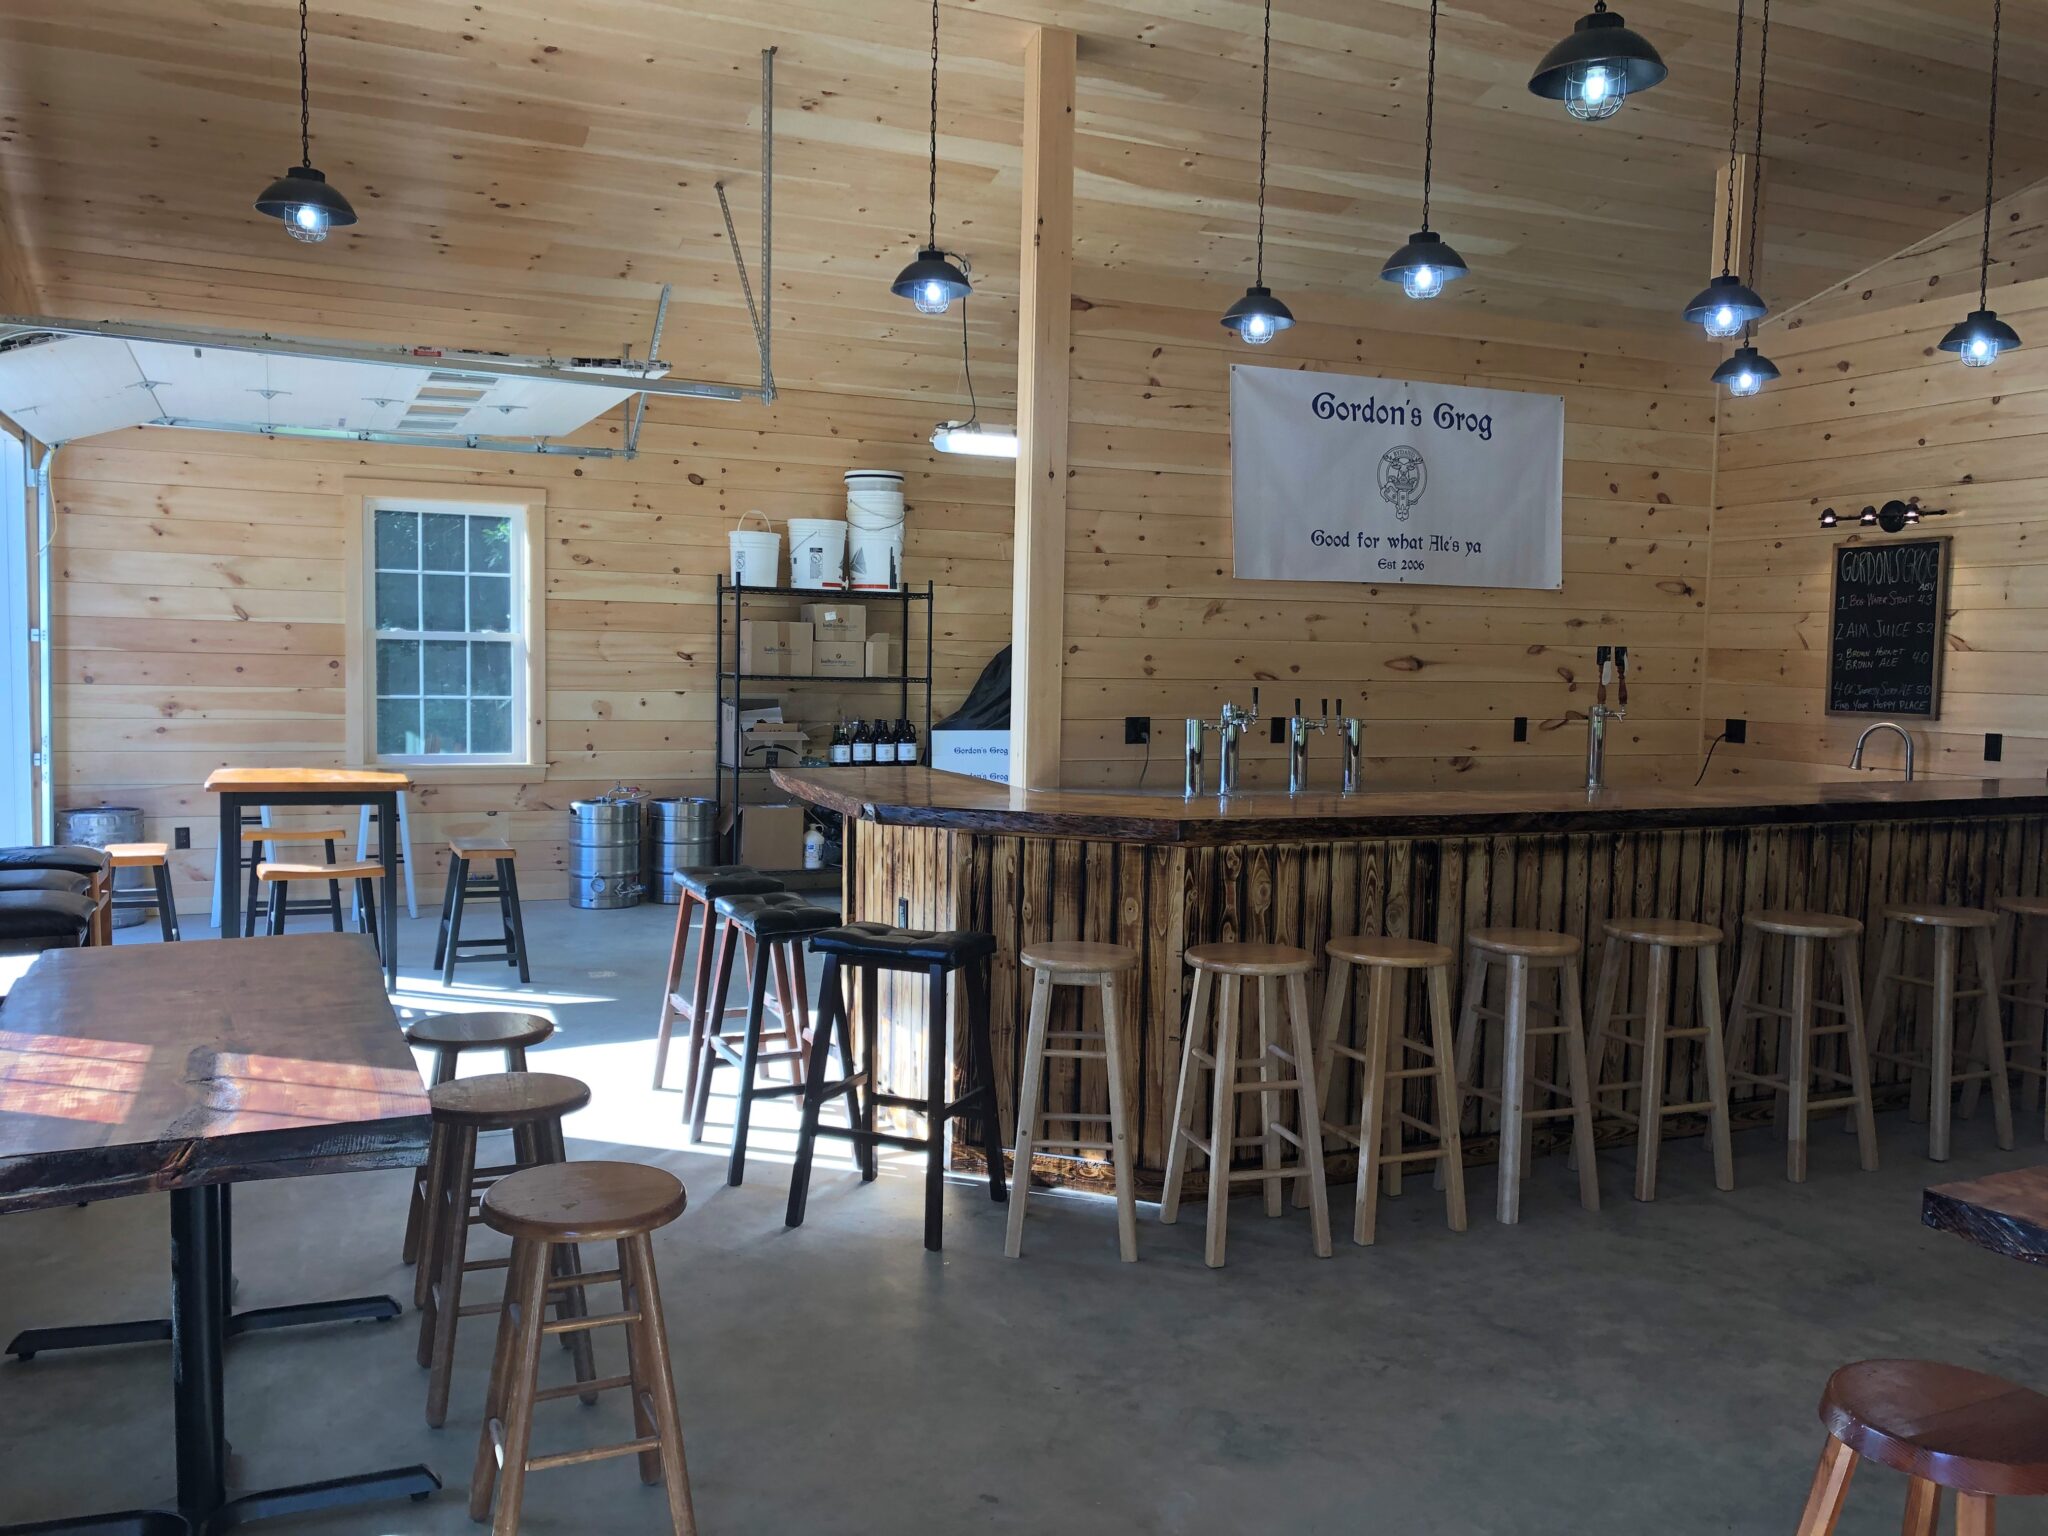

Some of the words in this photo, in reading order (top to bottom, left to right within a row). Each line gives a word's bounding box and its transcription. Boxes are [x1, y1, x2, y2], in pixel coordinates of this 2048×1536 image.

[1311, 392, 1422, 427] Gordon's
[1433, 402, 1493, 441] Grog
[1310, 529, 1350, 548] Good
[1357, 531, 1380, 549] for
[1387, 533, 1423, 551] what
[1428, 534, 1460, 553] Ale's
[1465, 540, 1482, 557] ya
[1377, 558, 1396, 570] Est
[1400, 559, 1425, 571] 2006
[1837, 596, 1848, 610] 1
[1835, 623, 1844, 640] 2
[1872, 620, 1912, 638] JUICE
[1846, 659, 1874, 671] BROWN
[1879, 657, 1899, 668] ALE
[1834, 681, 1844, 695] 4
[1899, 700, 1928, 711] PLACE
[953, 746, 987, 755] Gordon's
[989, 746, 1009, 756] Grog
[989, 772, 1009, 782] Grog
